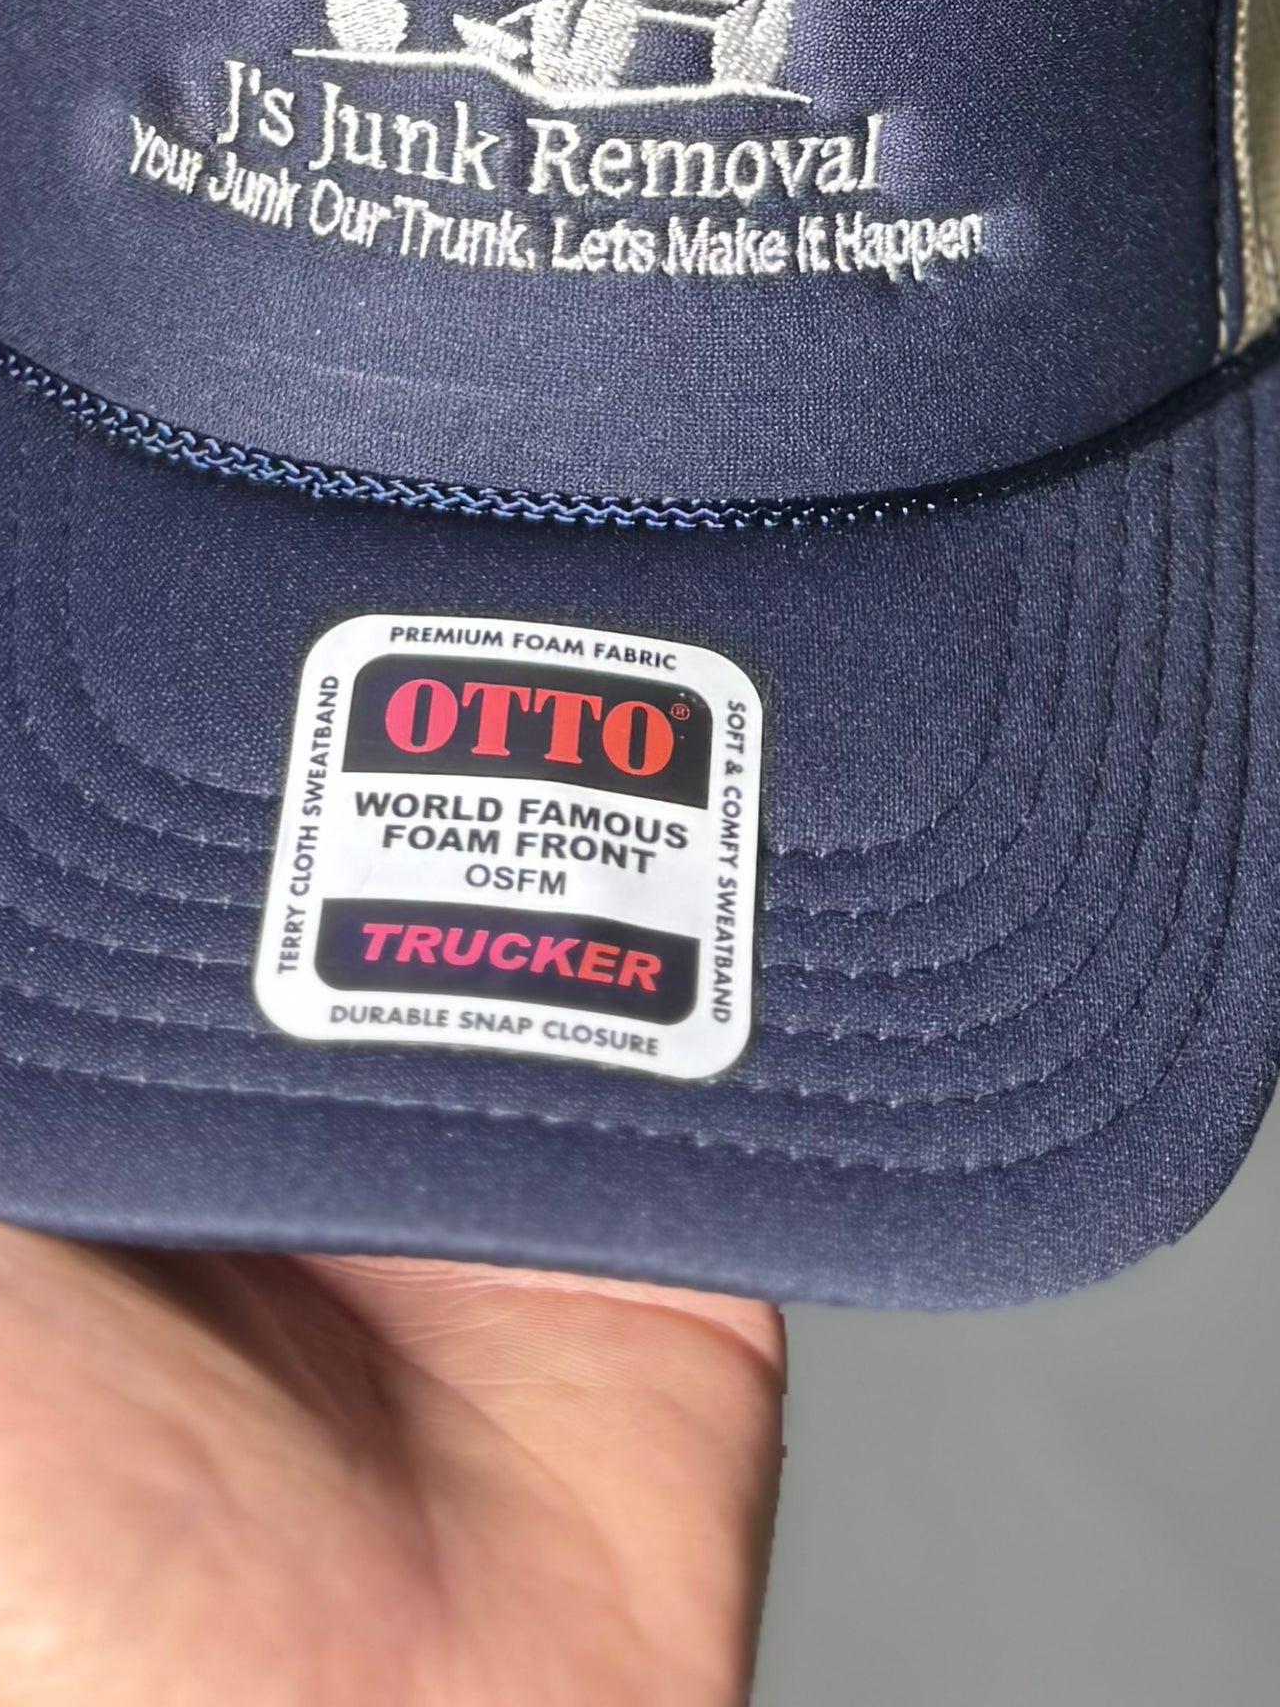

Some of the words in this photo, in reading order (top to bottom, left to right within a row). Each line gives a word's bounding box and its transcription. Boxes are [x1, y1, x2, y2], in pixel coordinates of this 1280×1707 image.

[217, 60, 295, 147] J's
[309, 81, 499, 190] Junk
[526, 113, 884, 201] Removal
[129, 114, 204, 194] Your
[208, 151, 302, 229] Junk
[308, 179, 391, 248] Our
[551, 217, 656, 274] Lets
[660, 216, 788, 277] Make
[796, 216, 831, 273] It
[835, 211, 984, 283] Happen
[389, 626, 504, 647] PREMIUM
[513, 632, 585, 656] FOAM
[593, 643, 677, 671] FABRIC
[302, 675, 340, 817] SWEATBAND
[724, 700, 747, 754] SOFT
[724, 759, 744, 775] &
[354, 791, 503, 822] WORLD
[518, 798, 689, 850] FAMOUS
[381, 824, 501, 855] FOAM
[515, 831, 657, 875] FRONT
[718, 785, 743, 870] COMFY
[289, 825, 319, 897] CLOTH
[464, 864, 567, 895] OSFM
[277, 905, 306, 975] TERRY
[361, 922, 663, 992] TRUCKER
[712, 875, 738, 1024] SWEATBAND
[329, 1004, 449, 1027] DURABLE
[457, 1010, 534, 1035] SNAP
[542, 1020, 659, 1057] CLOSURE
